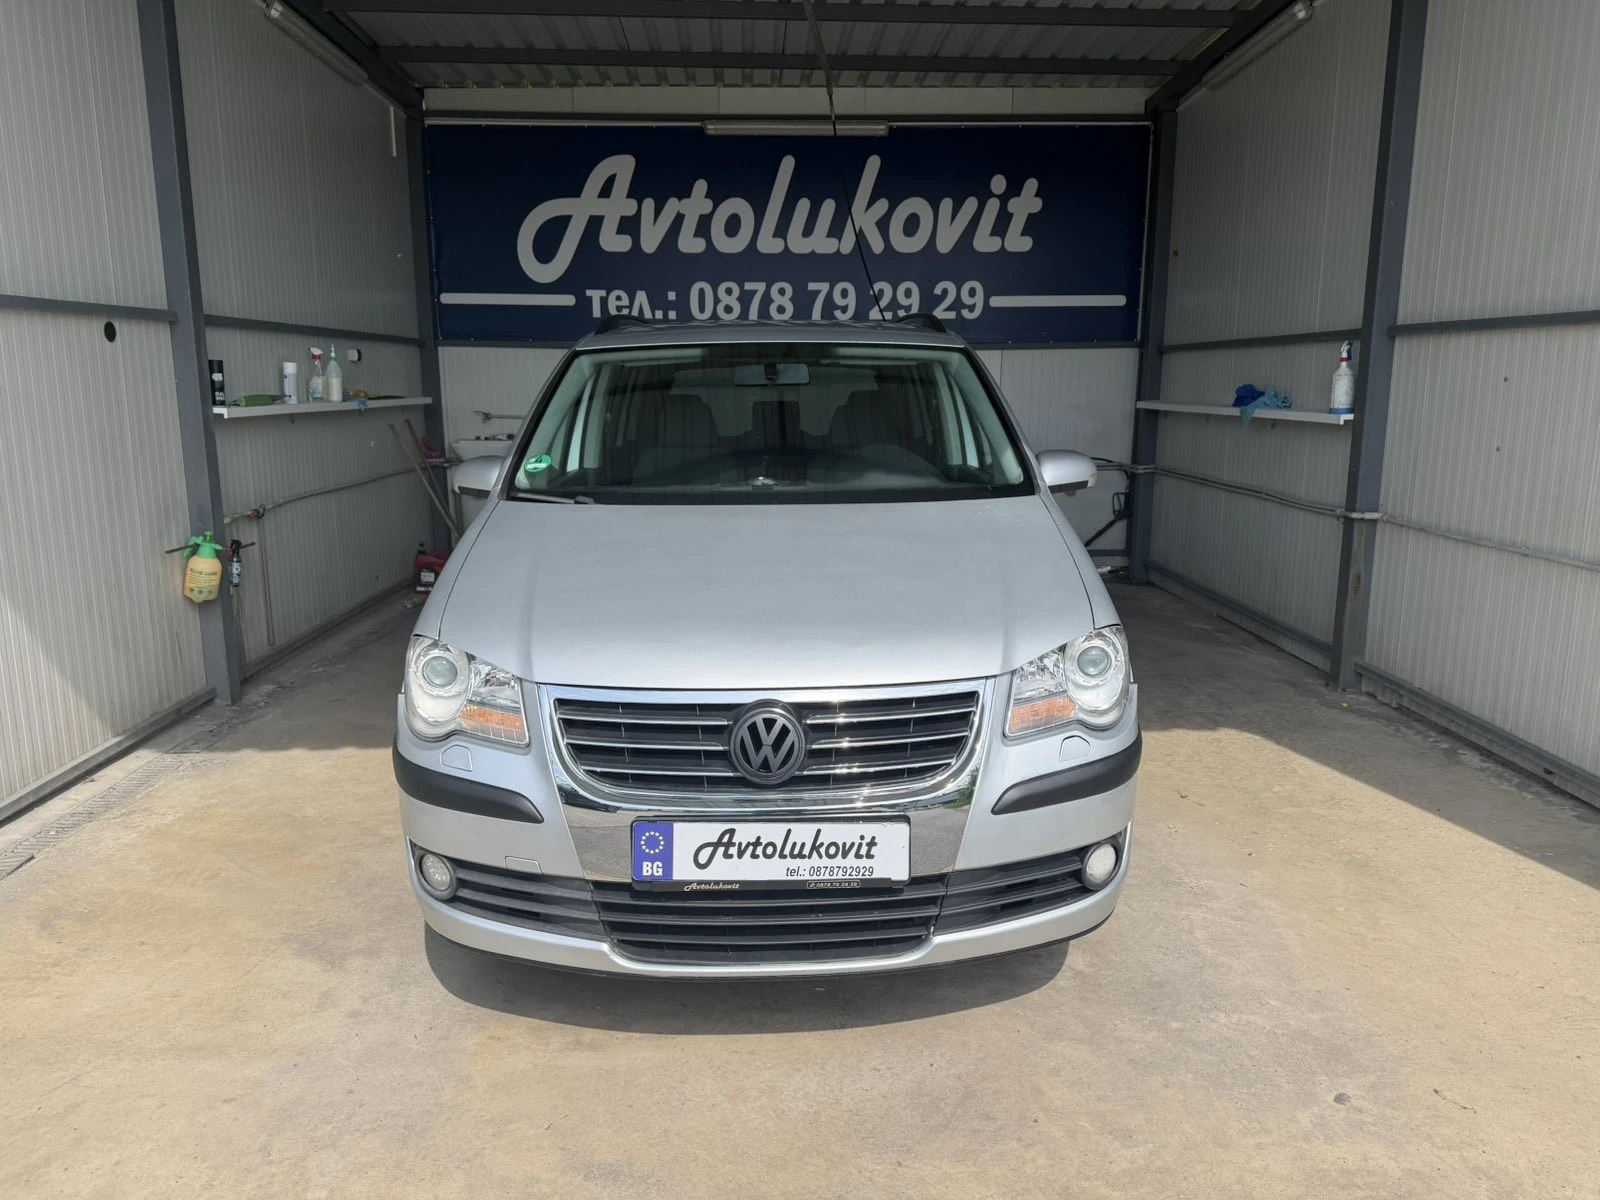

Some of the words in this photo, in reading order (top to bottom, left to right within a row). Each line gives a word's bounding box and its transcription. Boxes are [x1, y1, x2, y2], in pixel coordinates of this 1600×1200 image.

[518, 154, 1043, 283] Avtolukovit
[585, 290, 677, 320] тел.:
[689, 281, 794, 321] 0878
[807, 281, 857, 321] 79
[868, 280, 920, 320] 29
[932, 280, 984, 320] 29
[735, 712, 799, 777] VW
[642, 861, 664, 877] BG
[693, 827, 878, 870] Avtolukovit
[684, 882, 740, 892] Avtolukovit
[785, 866, 807, 877] tel.:
[808, 865, 874, 878] 0878792929
